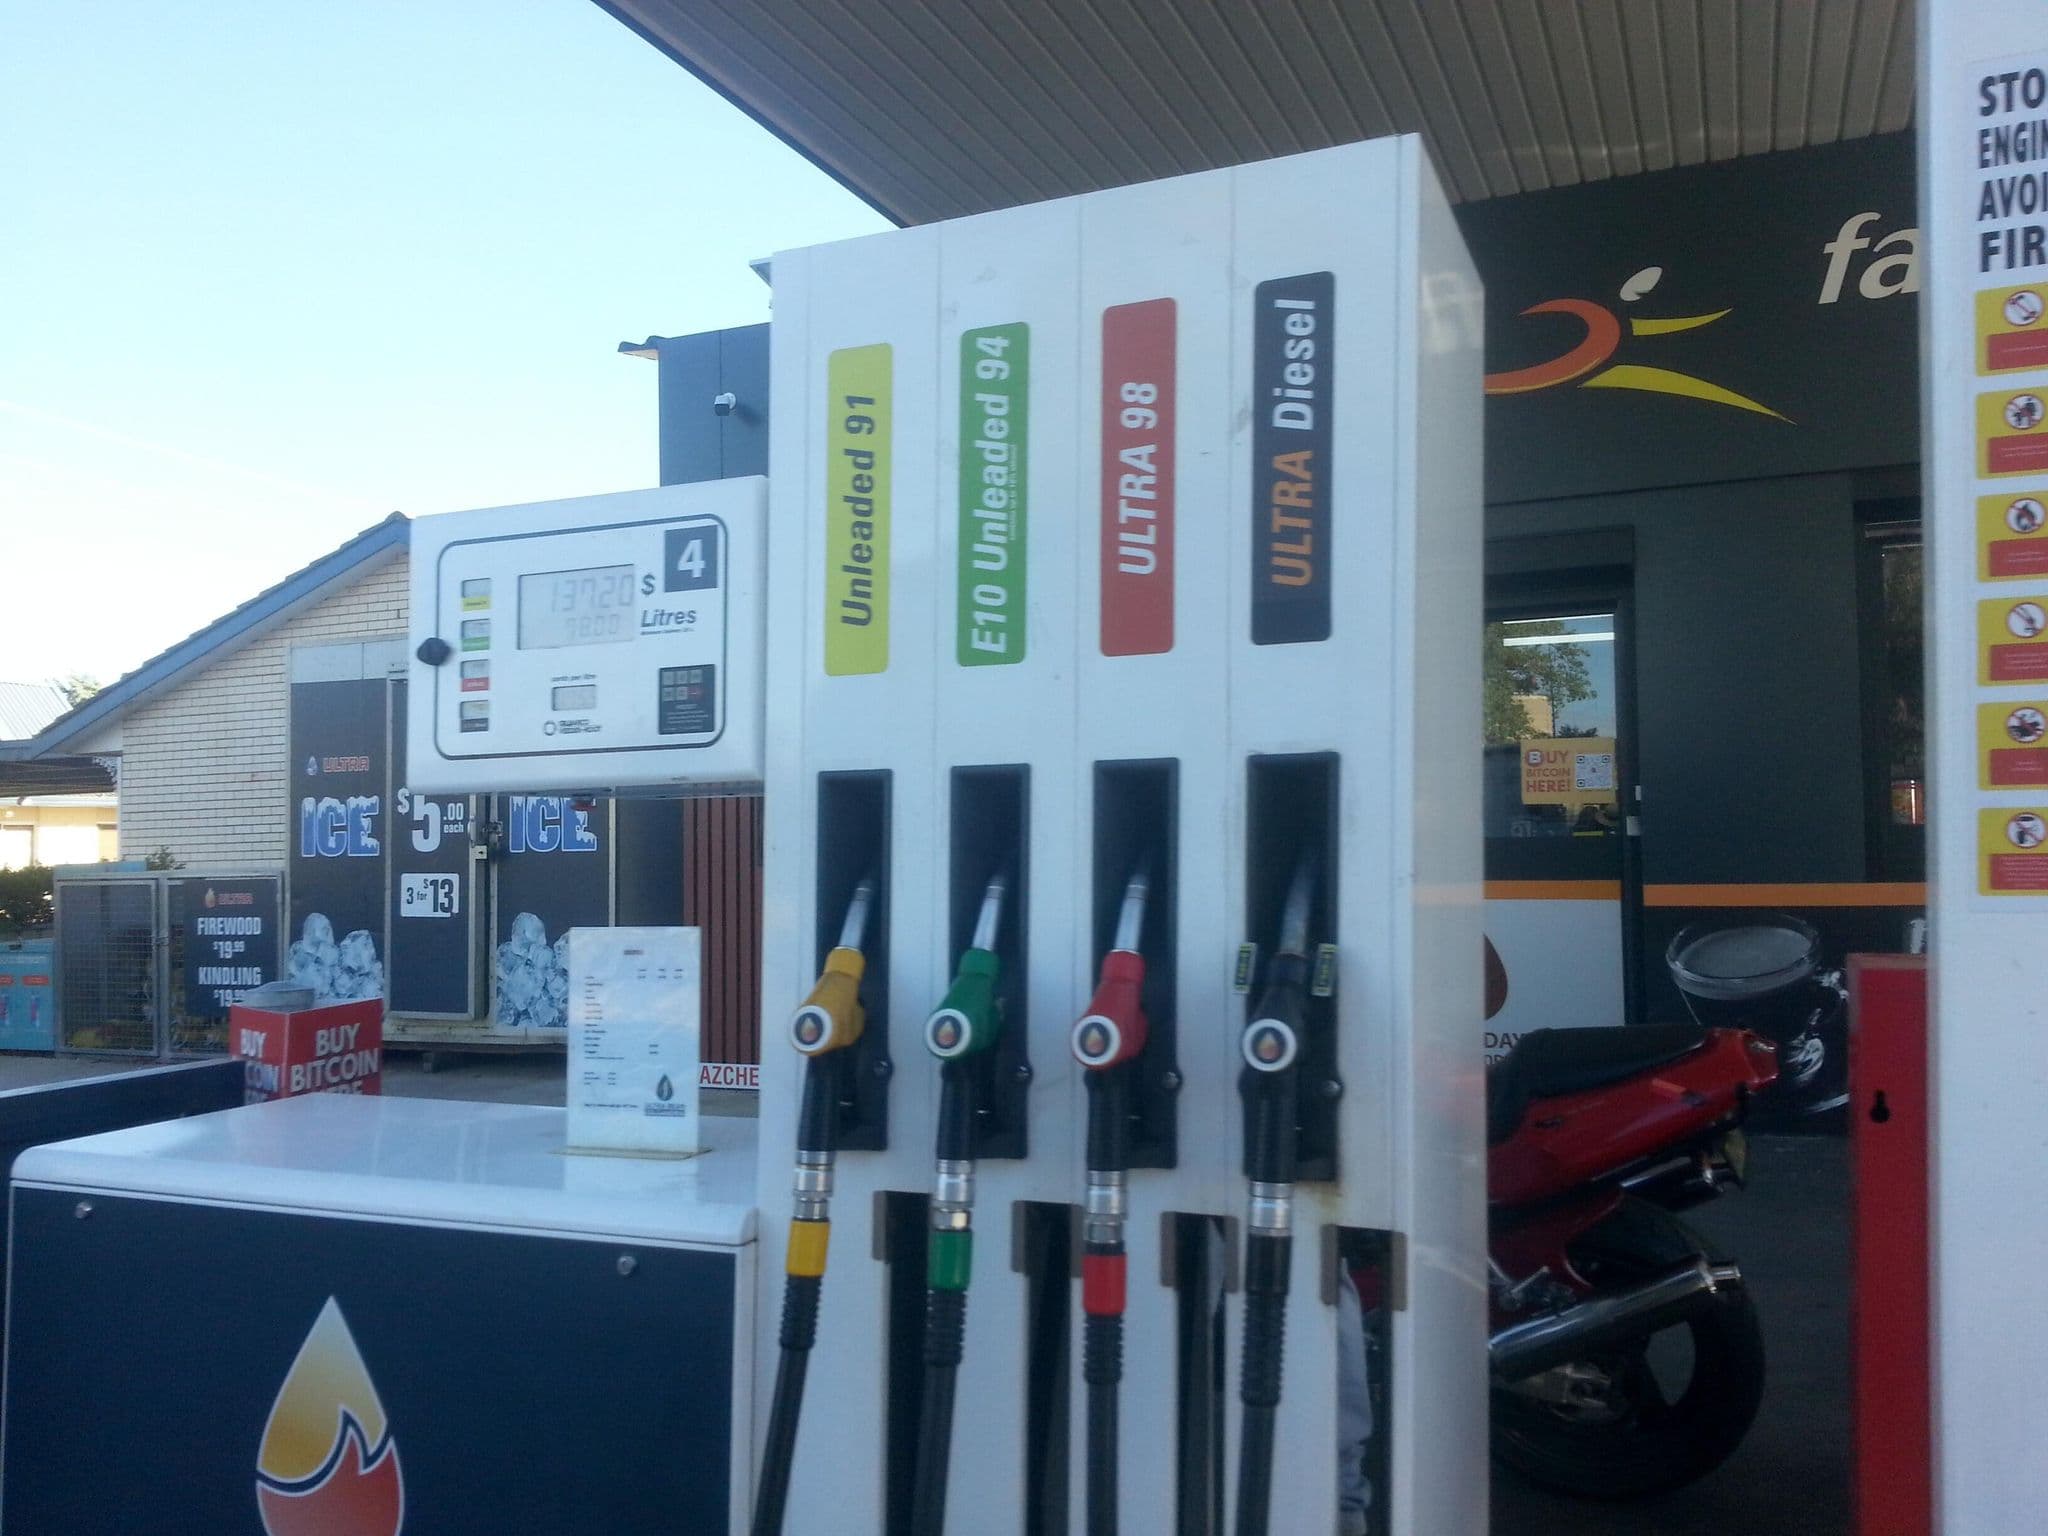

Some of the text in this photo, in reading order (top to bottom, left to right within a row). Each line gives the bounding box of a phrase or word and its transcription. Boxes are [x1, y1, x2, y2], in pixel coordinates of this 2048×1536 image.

[1979, 68, 2046, 117] STO
[1980, 225, 2047, 272] FIR
[1271, 299, 1317, 588] ULTRA Diesel
[971, 335, 1011, 654] E10 Unleaded 94
[1119, 382, 1159, 575] ULTRA 98
[841, 394, 876, 627] Unleaded 91
[677, 538, 706, 578] 4
[641, 573, 656, 596] $
[640, 608, 697, 628] Litres
[323, 756, 369, 773] ULTRA
[1526, 748, 1569, 767] BUY
[1526, 767, 1570, 778] BITCOIN
[1526, 779, 1570, 793] HERE!
[301, 796, 380, 857] ICE
[443, 821, 464, 834] each
[509, 796, 597, 853] ICE
[406, 878, 454, 913] 3 for $13
[197, 917, 262, 935] FIREWOOD
[198, 966, 262, 985] KINDLING
[240, 1028, 267, 1058] BUY
[316, 1023, 361, 1057] BUY
[290, 1048, 379, 1093] BITCOIN
[700, 1065, 759, 1087] AZCHE
